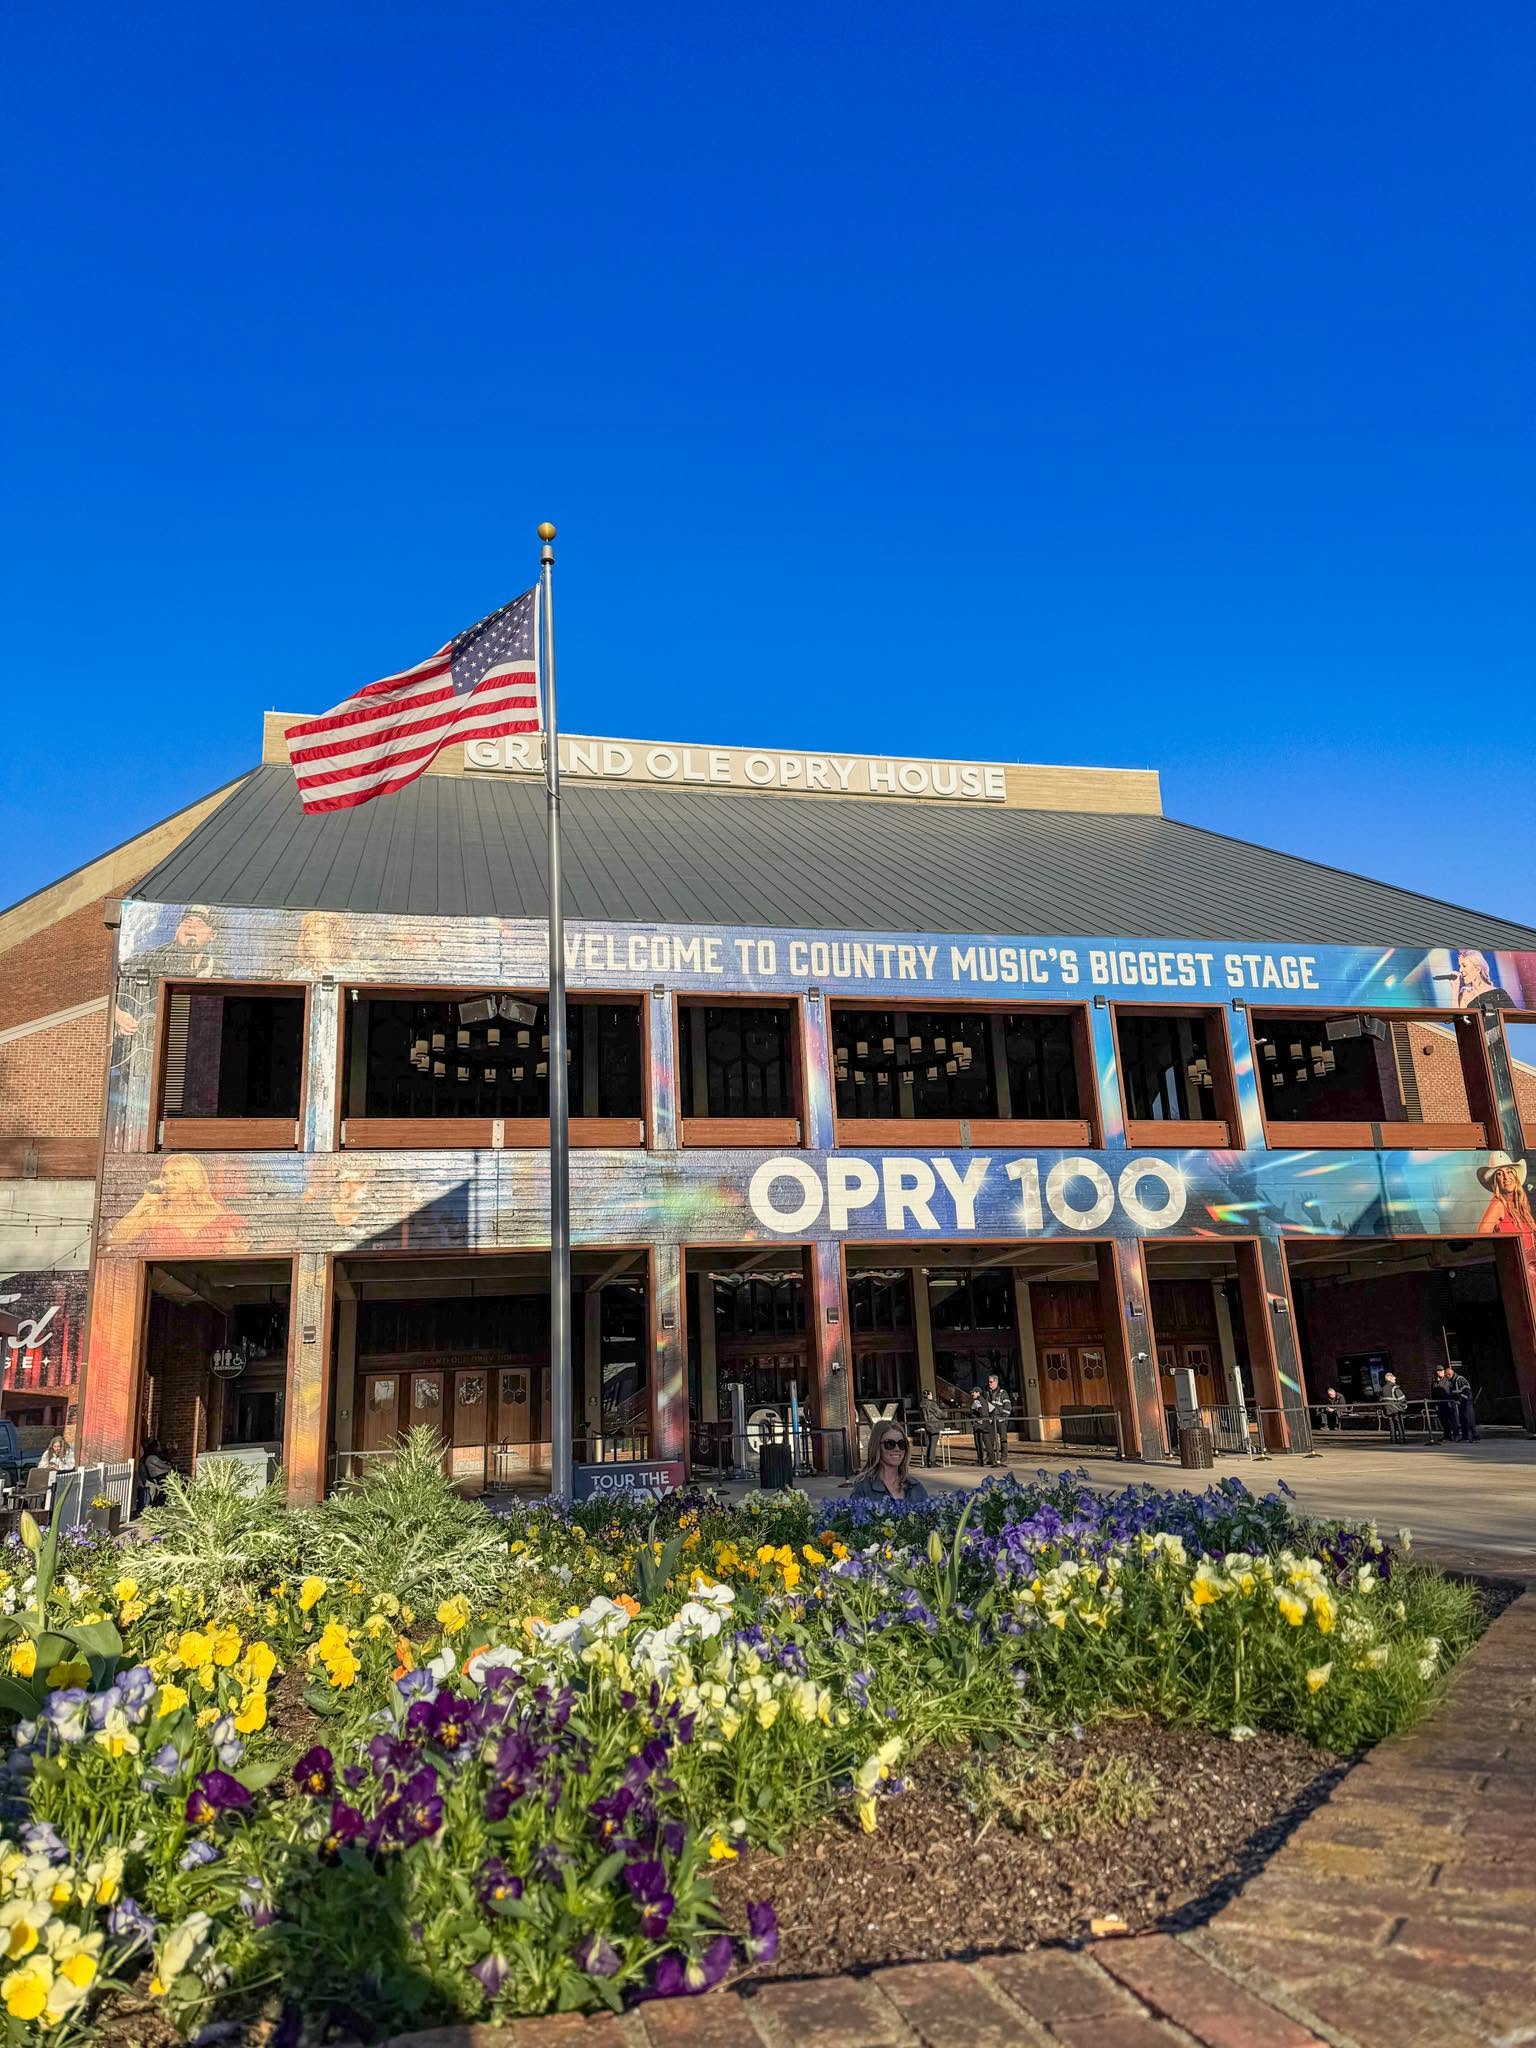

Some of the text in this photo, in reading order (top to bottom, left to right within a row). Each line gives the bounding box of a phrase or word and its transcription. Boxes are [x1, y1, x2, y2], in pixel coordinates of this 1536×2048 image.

[646, 747, 731, 783] OLE
[744, 753, 856, 790] OPRY
[868, 761, 1006, 799] HOUSE
[543, 932, 1320, 990] WELCOME TO COUNTRY MUSIC'S BIGGEST STAGE
[748, 1156, 1188, 1234] OPRY 100
[591, 1470, 670, 1488] TOUR THE
